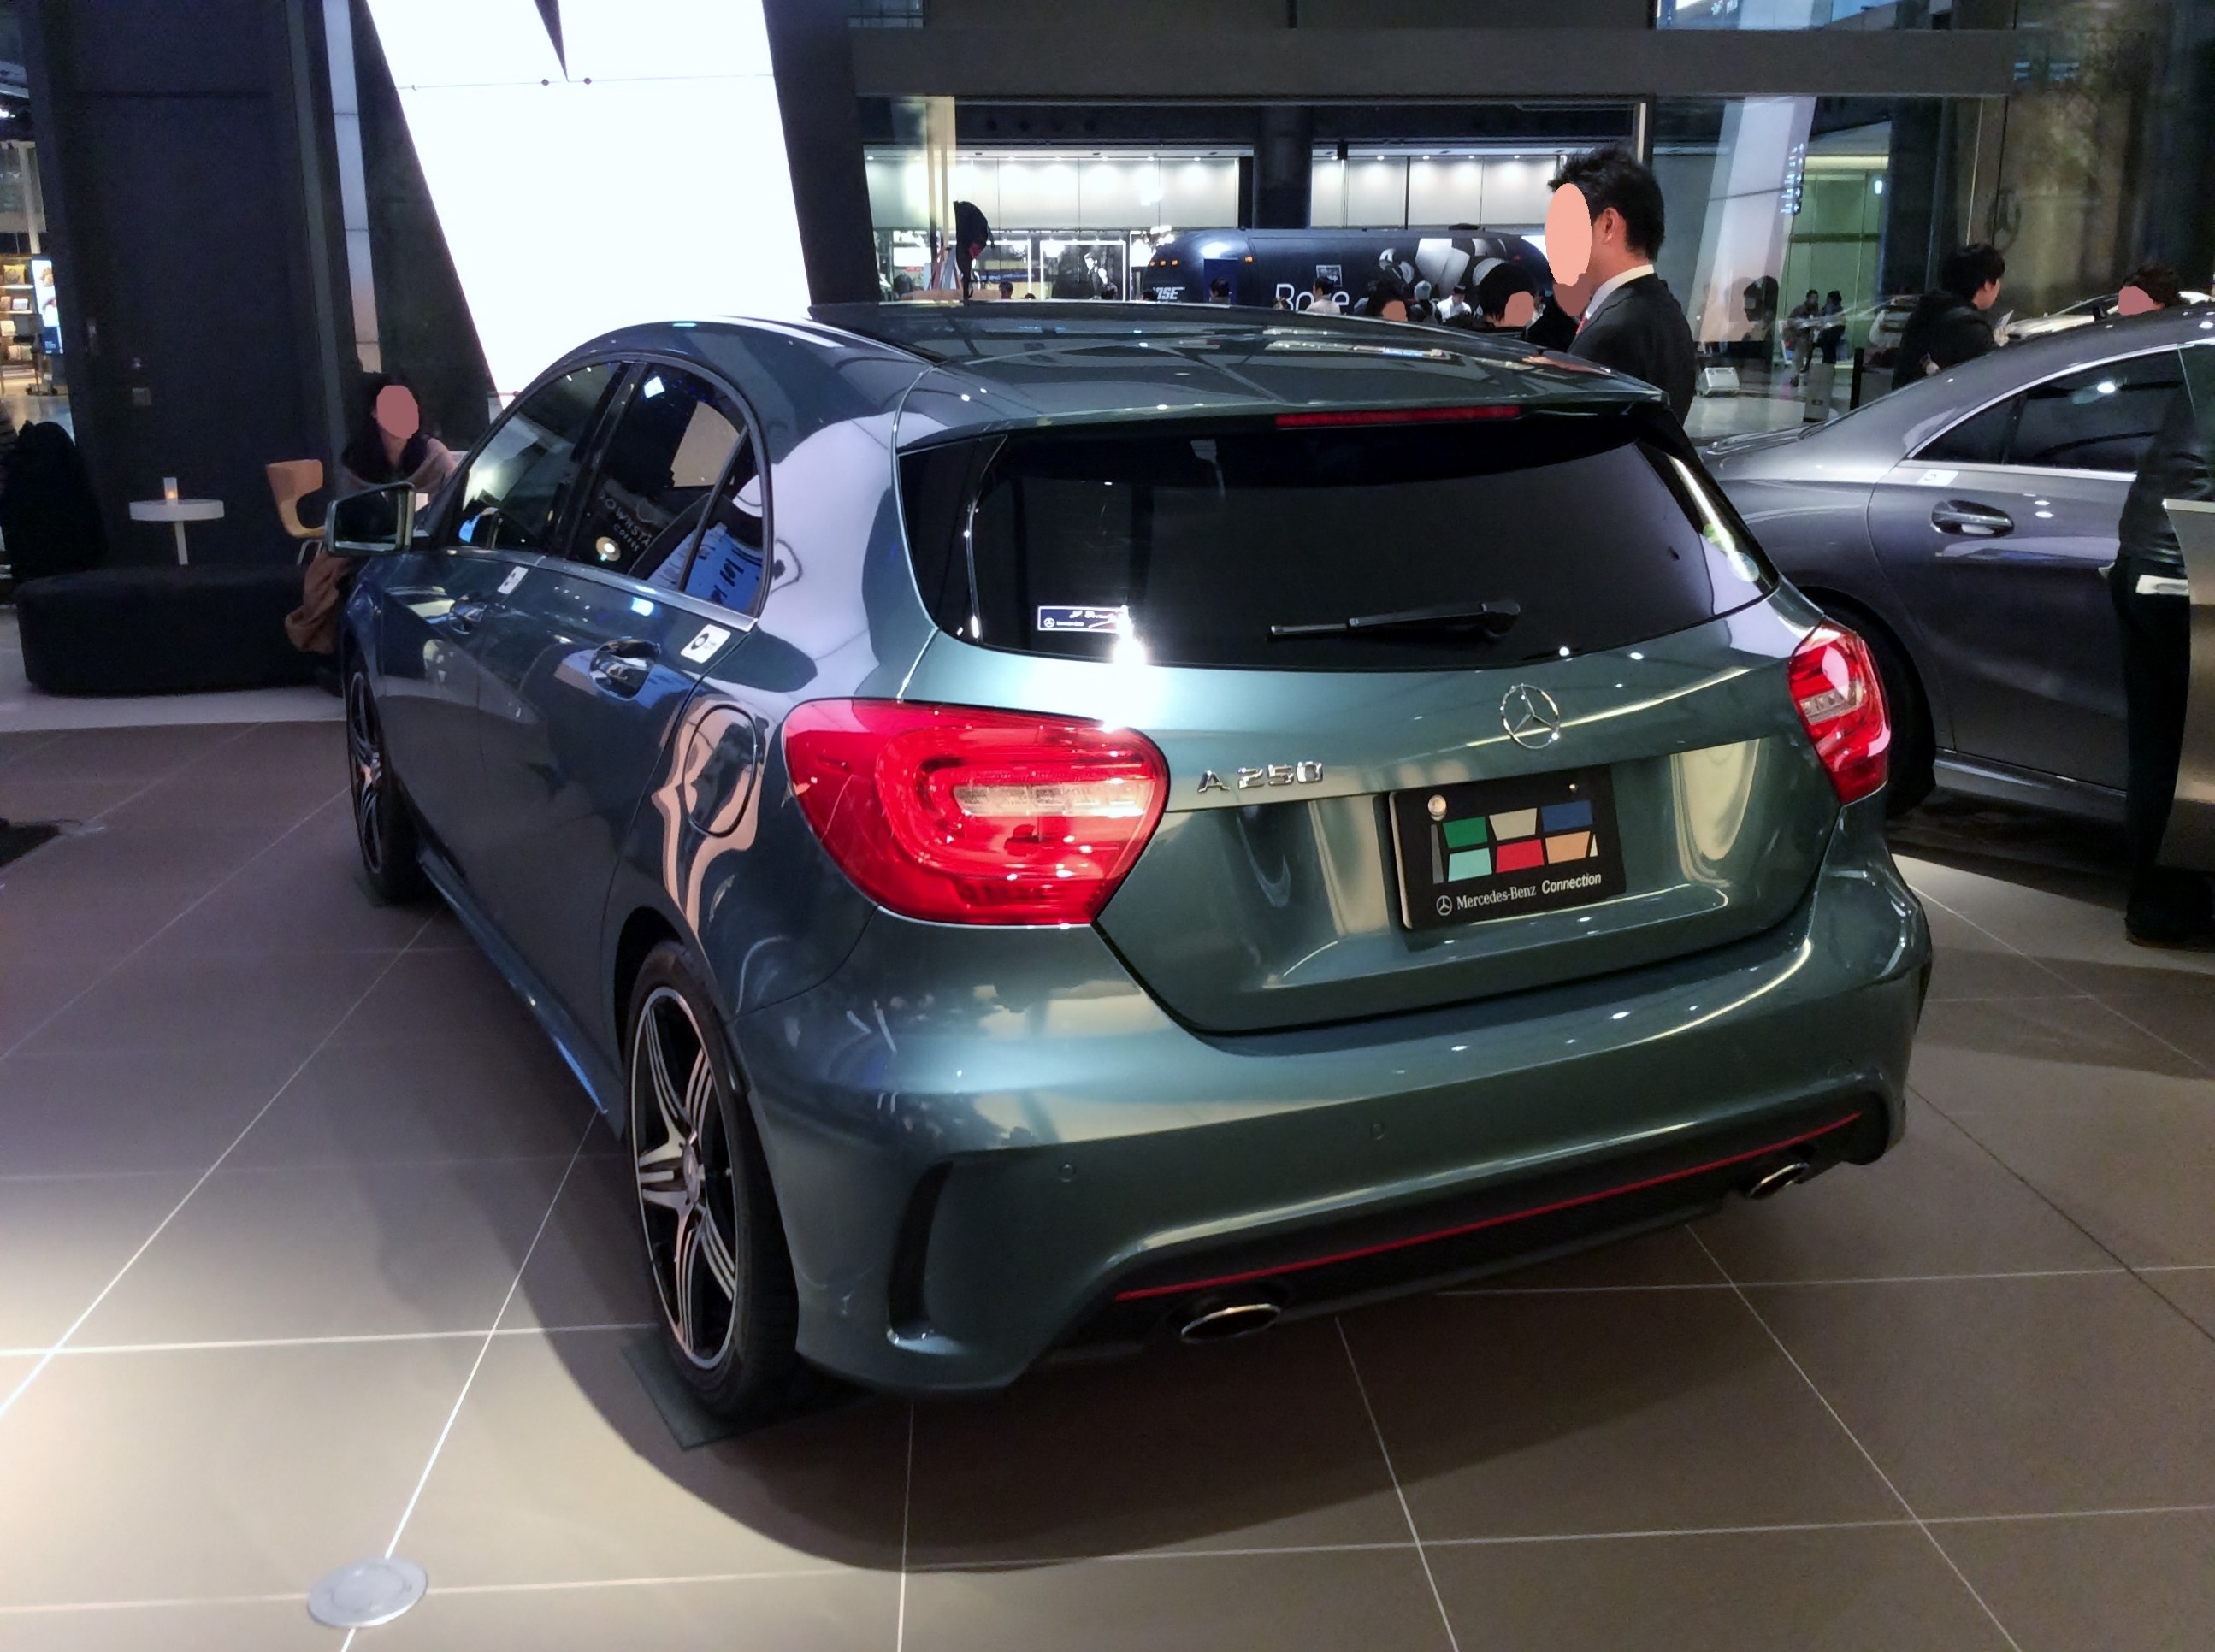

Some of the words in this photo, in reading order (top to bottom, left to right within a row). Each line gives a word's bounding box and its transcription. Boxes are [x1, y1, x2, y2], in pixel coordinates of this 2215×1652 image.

[1197, 769, 1231, 793] A
[1237, 760, 1324, 790] 250
[1456, 885, 1537, 911] Mercedes-Benz
[1541, 872, 1602, 894] Connection
